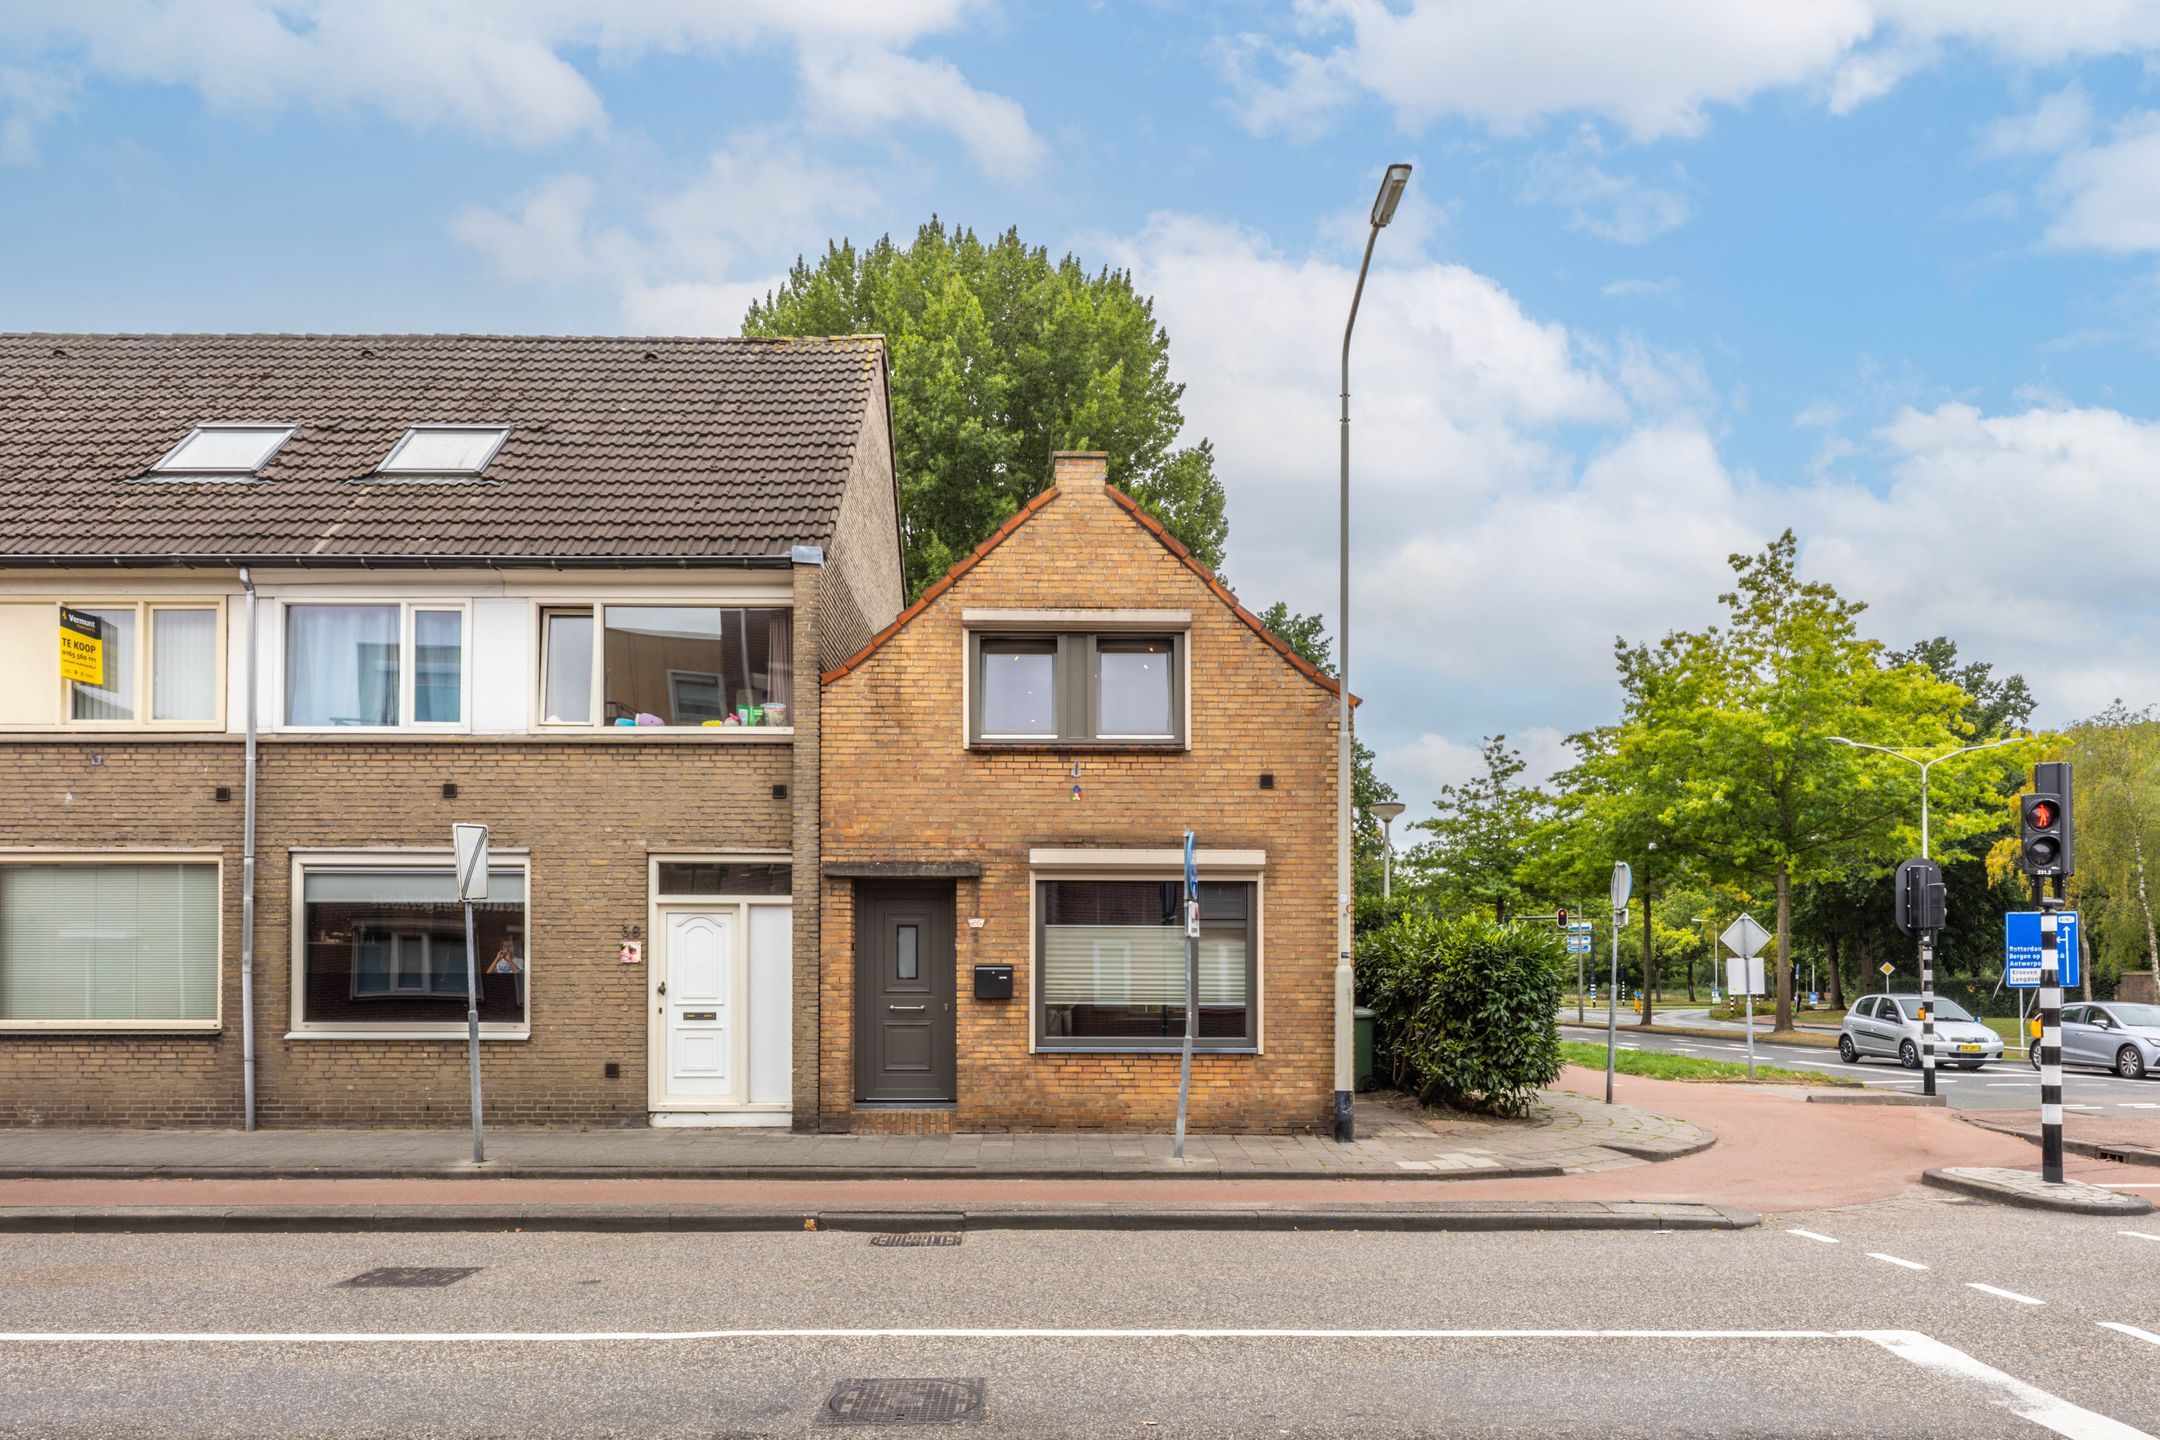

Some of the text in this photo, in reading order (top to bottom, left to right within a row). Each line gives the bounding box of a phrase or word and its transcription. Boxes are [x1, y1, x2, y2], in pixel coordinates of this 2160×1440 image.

[68, 613, 96, 628] Vermunt
[62, 637, 96, 654] TE KOOP
